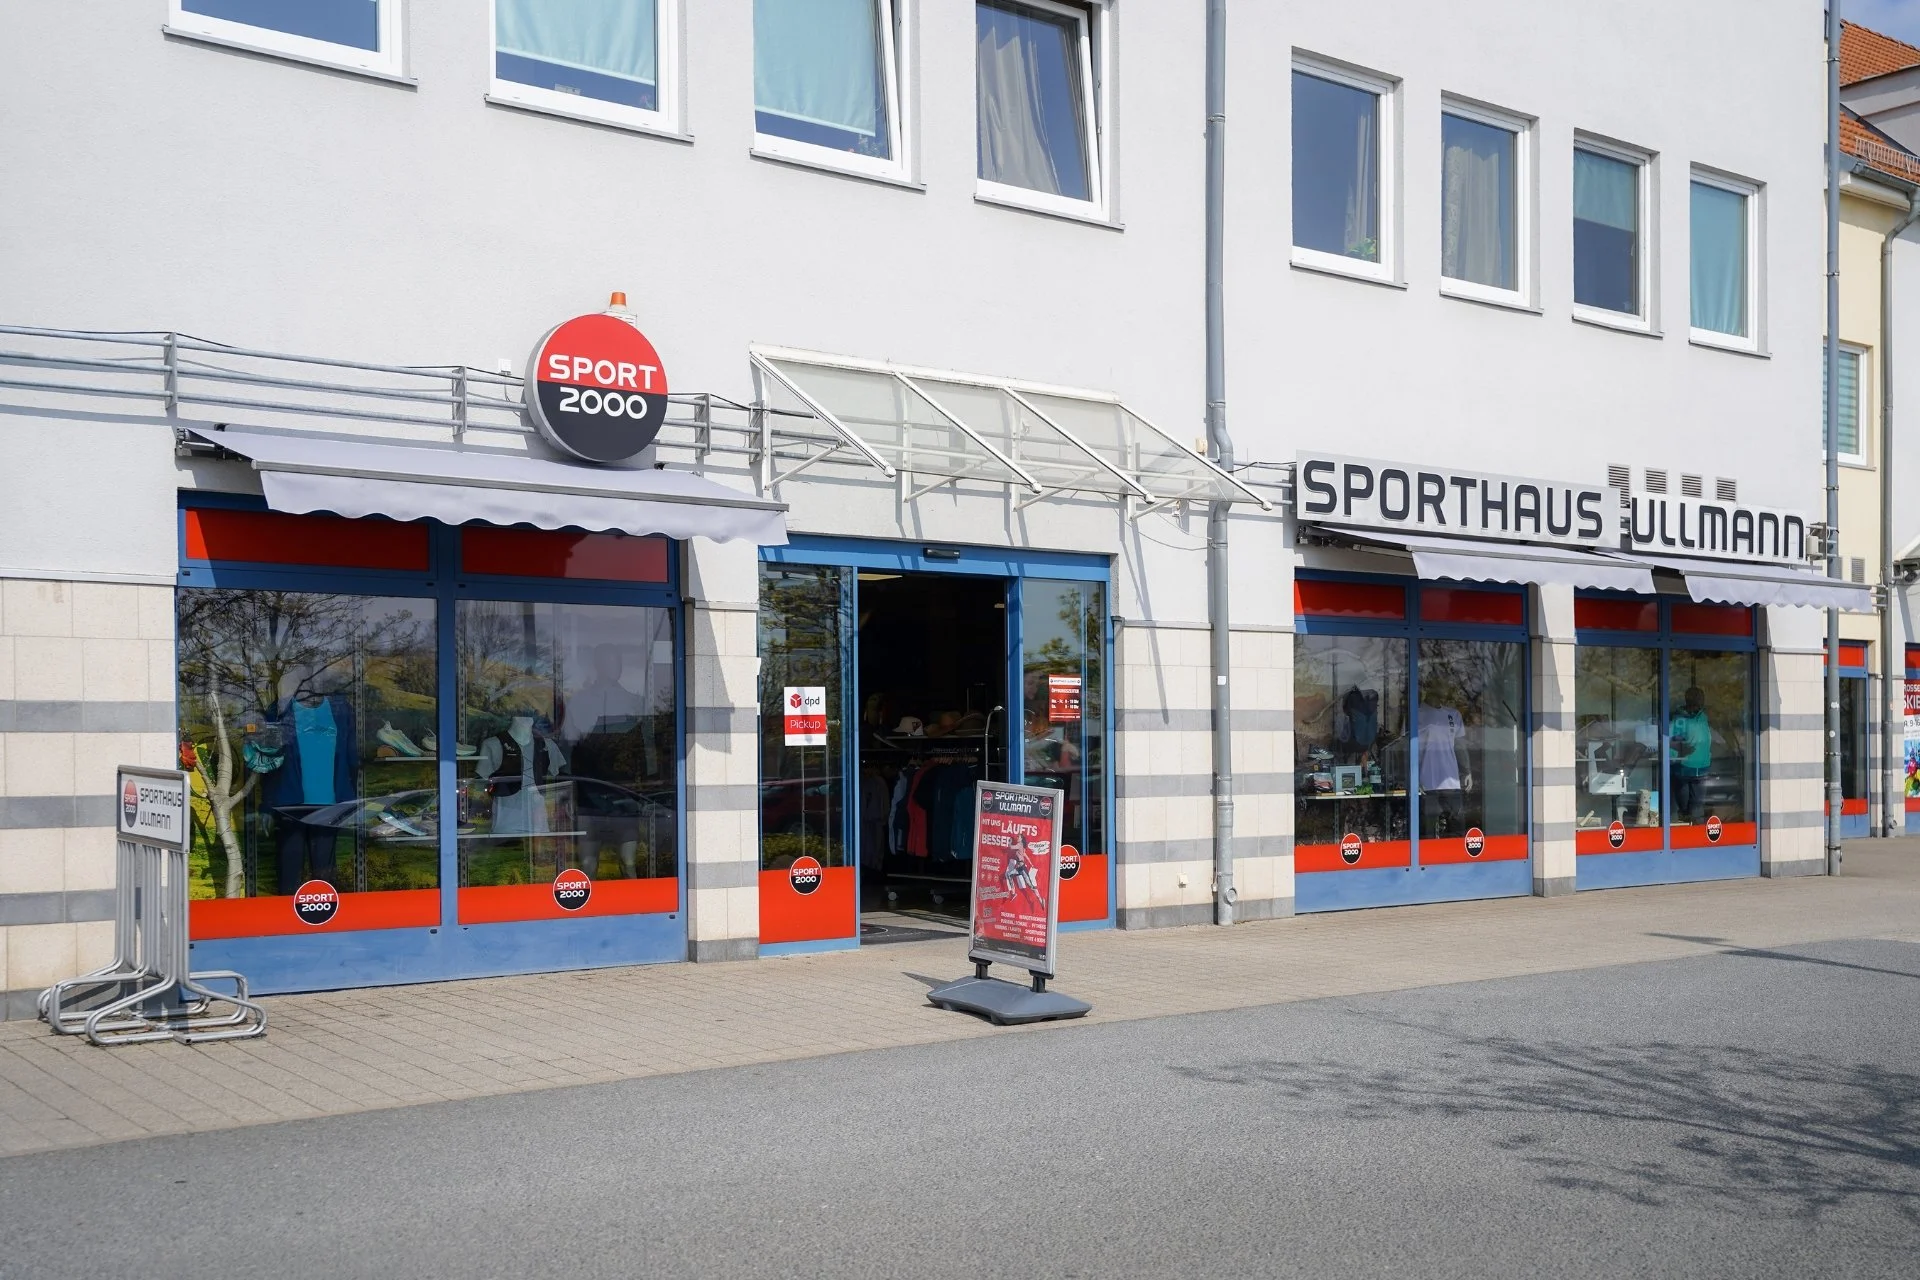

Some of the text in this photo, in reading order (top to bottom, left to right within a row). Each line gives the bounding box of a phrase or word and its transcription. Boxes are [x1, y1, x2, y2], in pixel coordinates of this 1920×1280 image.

[549, 354, 657, 389] SPORT
[559, 386, 648, 420] 2000
[1303, 459, 1804, 560] SPORTHAUS ULLMANN
[804, 696, 820, 707] dpd
[790, 719, 821, 730] Pickup
[140, 787, 182, 808] SPORTHAUS
[995, 791, 1039, 803] SPORTHAUS
[1000, 802, 1031, 814] ULLMANN
[140, 810, 171, 830] ULLMANN
[1001, 821, 1038, 837] LÄUFTS
[981, 833, 1012, 848] BESSER
[1342, 842, 1360, 850] SPORT
[1060, 855, 1078, 863] PORT
[793, 867, 819, 876] SPORT
[795, 875, 817, 884] 2000
[557, 881, 588, 890] SPORT
[298, 893, 335, 903] SPORT
[559, 889, 585, 899] 2000
[301, 902, 332, 912] 2000
